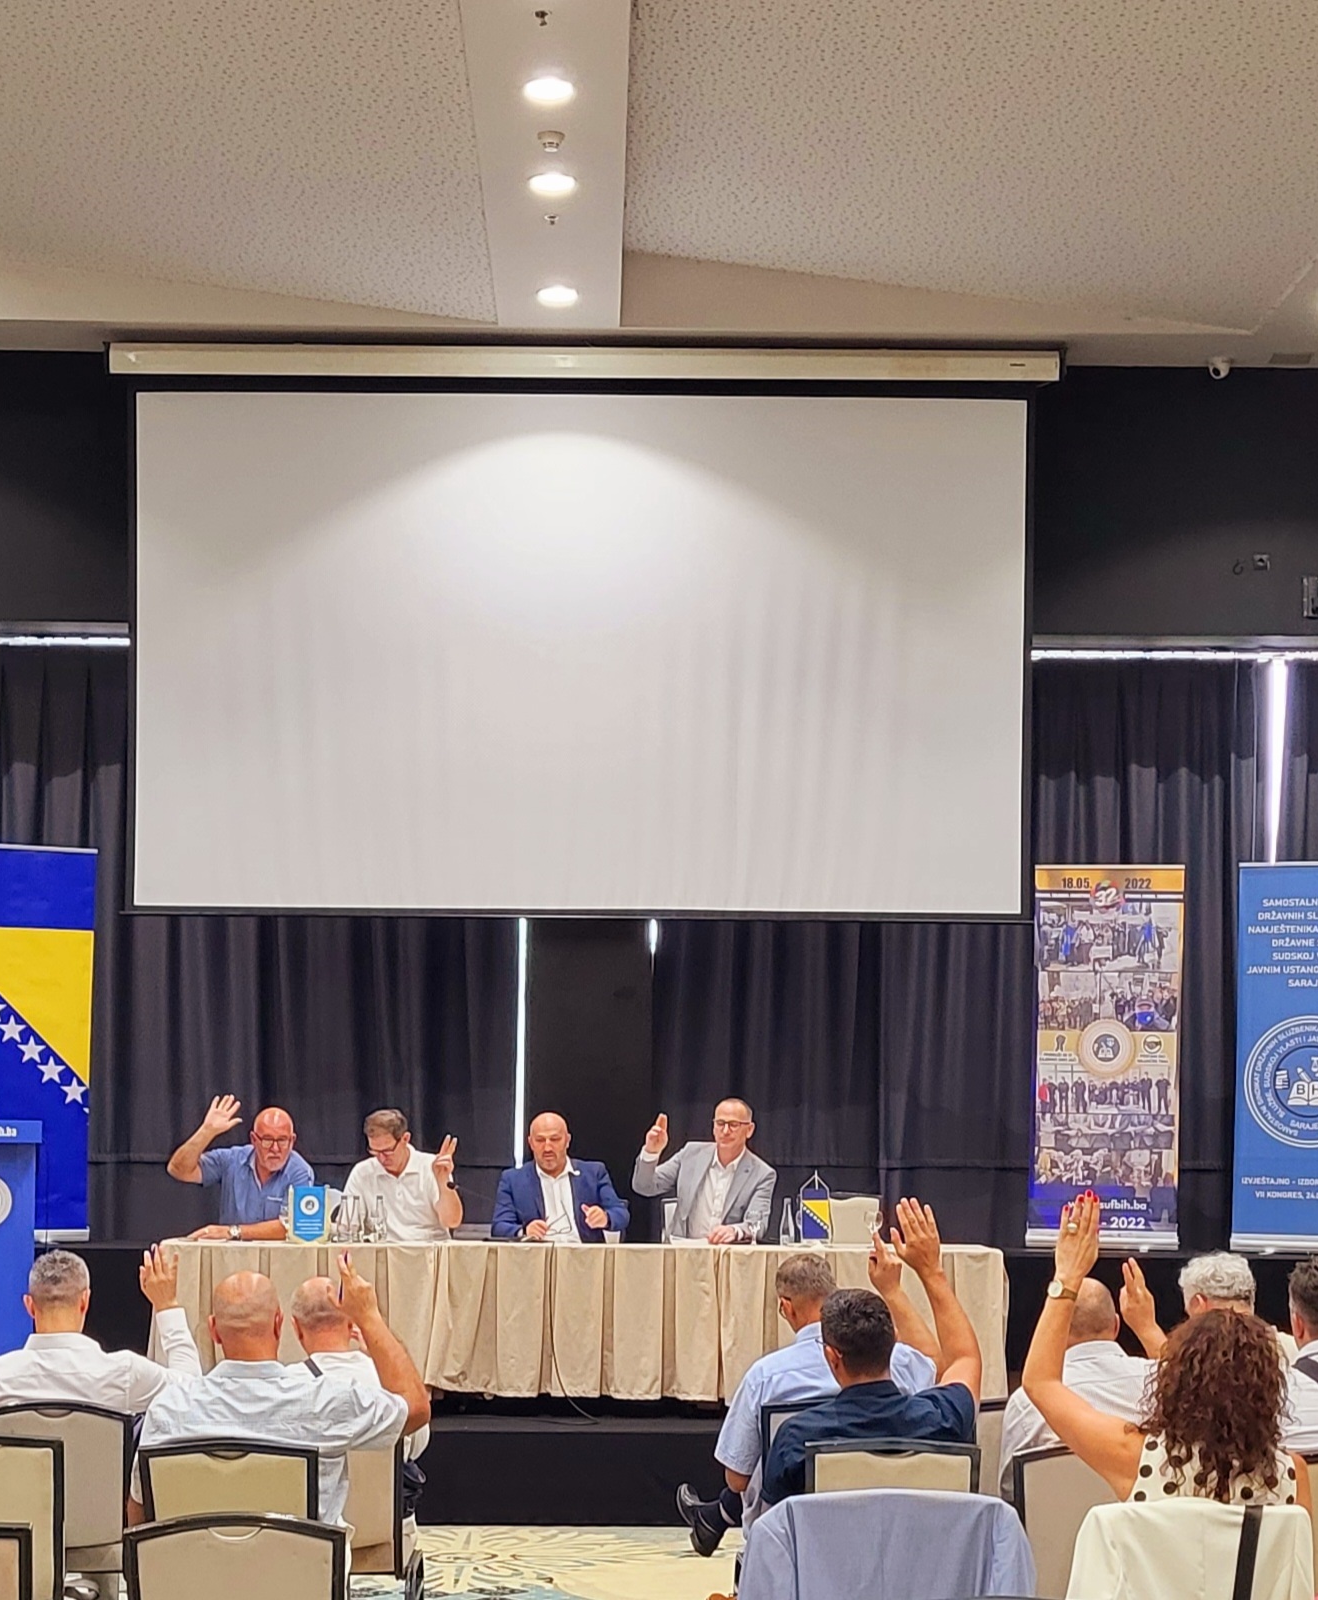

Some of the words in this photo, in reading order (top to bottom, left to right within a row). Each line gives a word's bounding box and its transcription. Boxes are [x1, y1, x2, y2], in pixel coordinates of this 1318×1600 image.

[1062, 877, 1092, 889] 18.05.
[1124, 877, 1152, 889] 2022
[1094, 887, 1118, 907] 32
[1257, 910, 1305, 920] DRŽAVNIH
[1247, 923, 1318, 934] NAMJEŠTENIKA
[1271, 937, 1315, 947] DRŽAVNE
[1272, 951, 1315, 960] SUDSKOJ
[1246, 965, 1281, 974] JAVNIM
[1296, 1084, 1306, 1095] B
[1241, 1175, 1290, 1186] IZVJEŠTAJNO
[1266, 1190, 1304, 1200] KONGRES,
[1110, 1216, 1146, 1229] 2022
